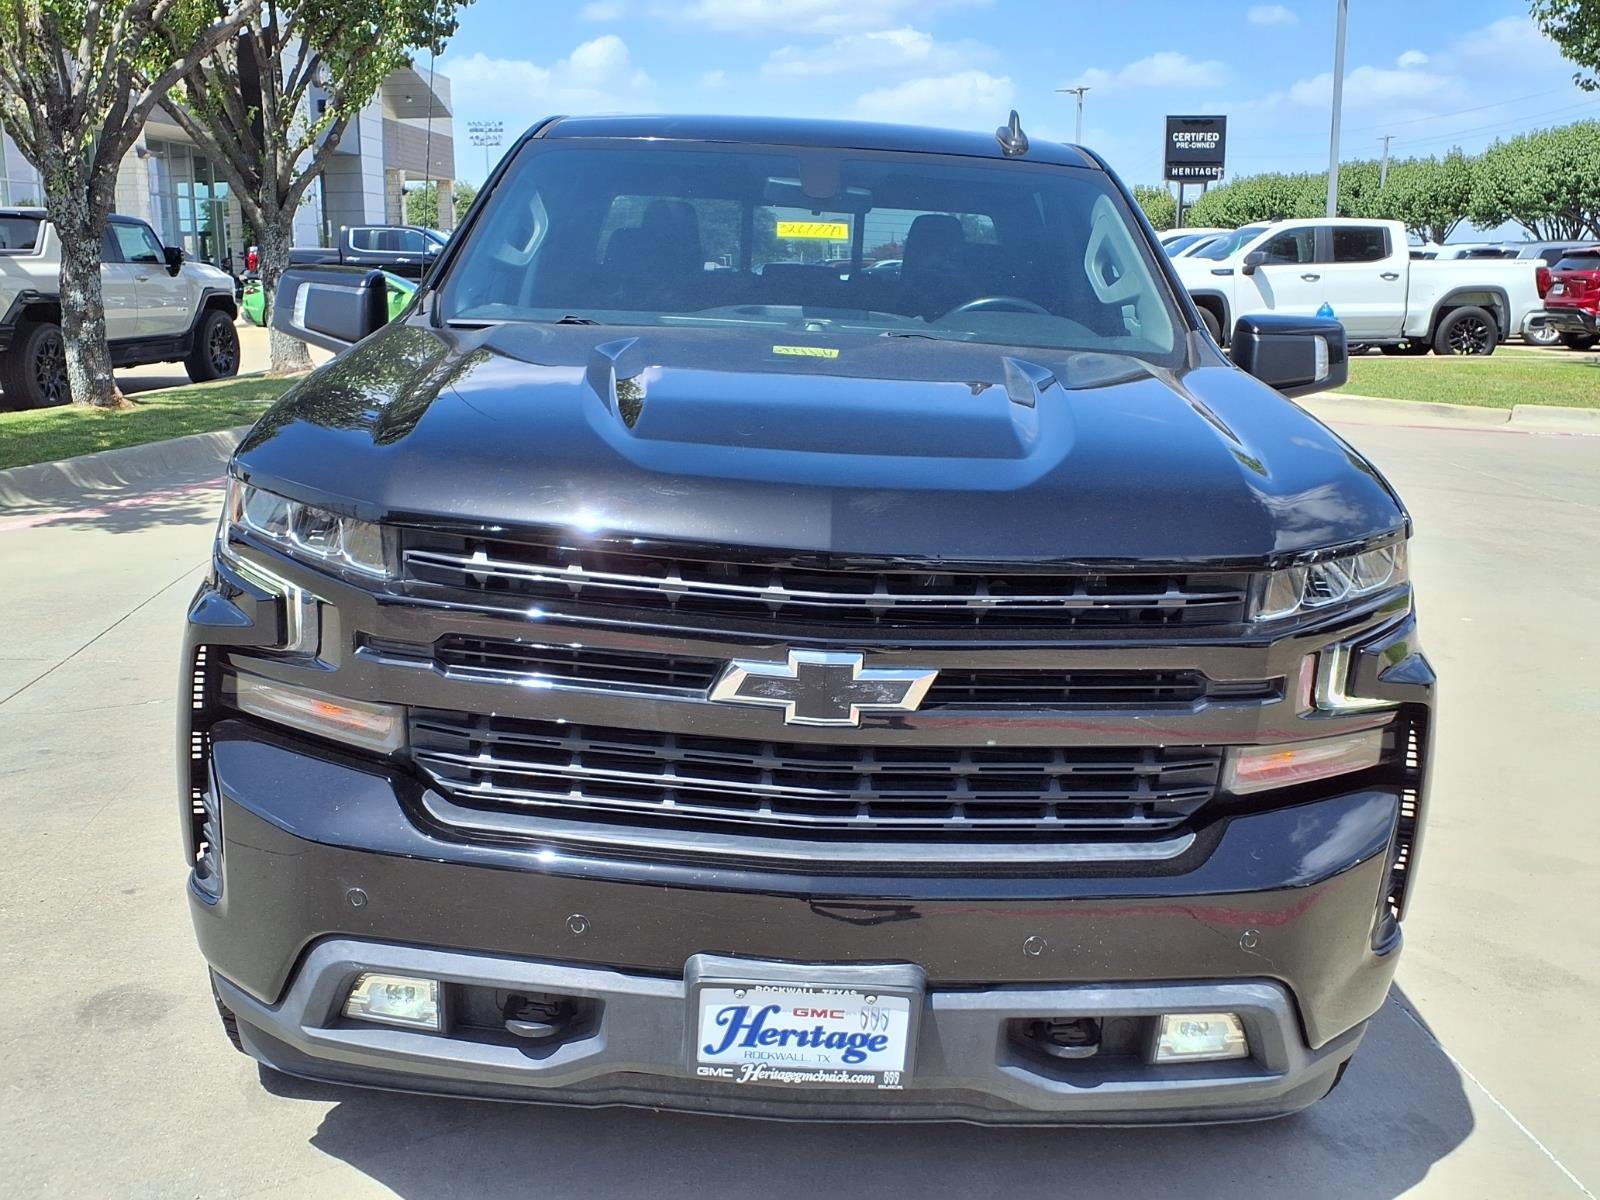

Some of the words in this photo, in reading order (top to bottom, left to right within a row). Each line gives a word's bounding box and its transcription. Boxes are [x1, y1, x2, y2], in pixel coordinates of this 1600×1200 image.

[1172, 132, 1220, 142] CERTIFIED
[1171, 167, 1219, 176] HERITAGE
[822, 989, 858, 997] TEXAS
[793, 1007, 846, 1020] GMC
[703, 1005, 888, 1064] Heritage
[817, 1054, 832, 1063] TX
[696, 1066, 734, 1078] GMC
[737, 1063, 875, 1084] Heritagegmcbuick.com
